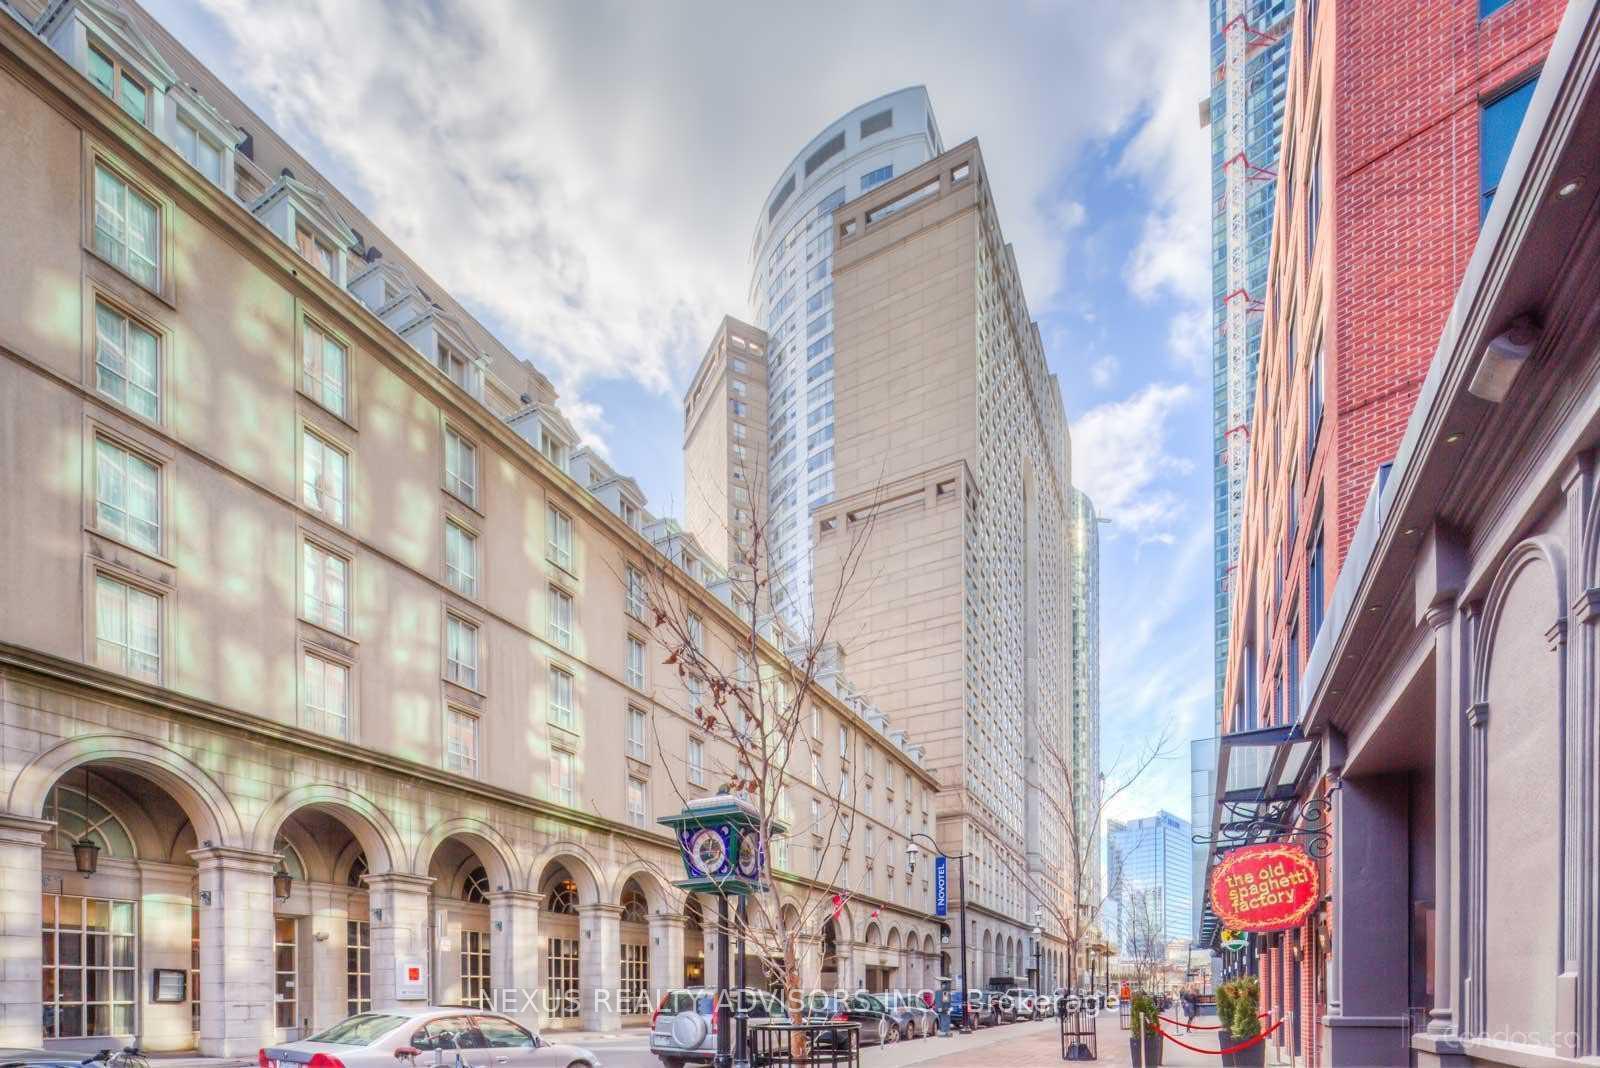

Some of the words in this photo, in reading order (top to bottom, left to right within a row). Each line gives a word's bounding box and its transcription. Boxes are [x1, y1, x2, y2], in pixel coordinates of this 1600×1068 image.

[1226, 872, 1254, 888] the
[1259, 861, 1284, 879] old
[1229, 869, 1308, 901] spaghetti
[1232, 888, 1295, 913] factory
